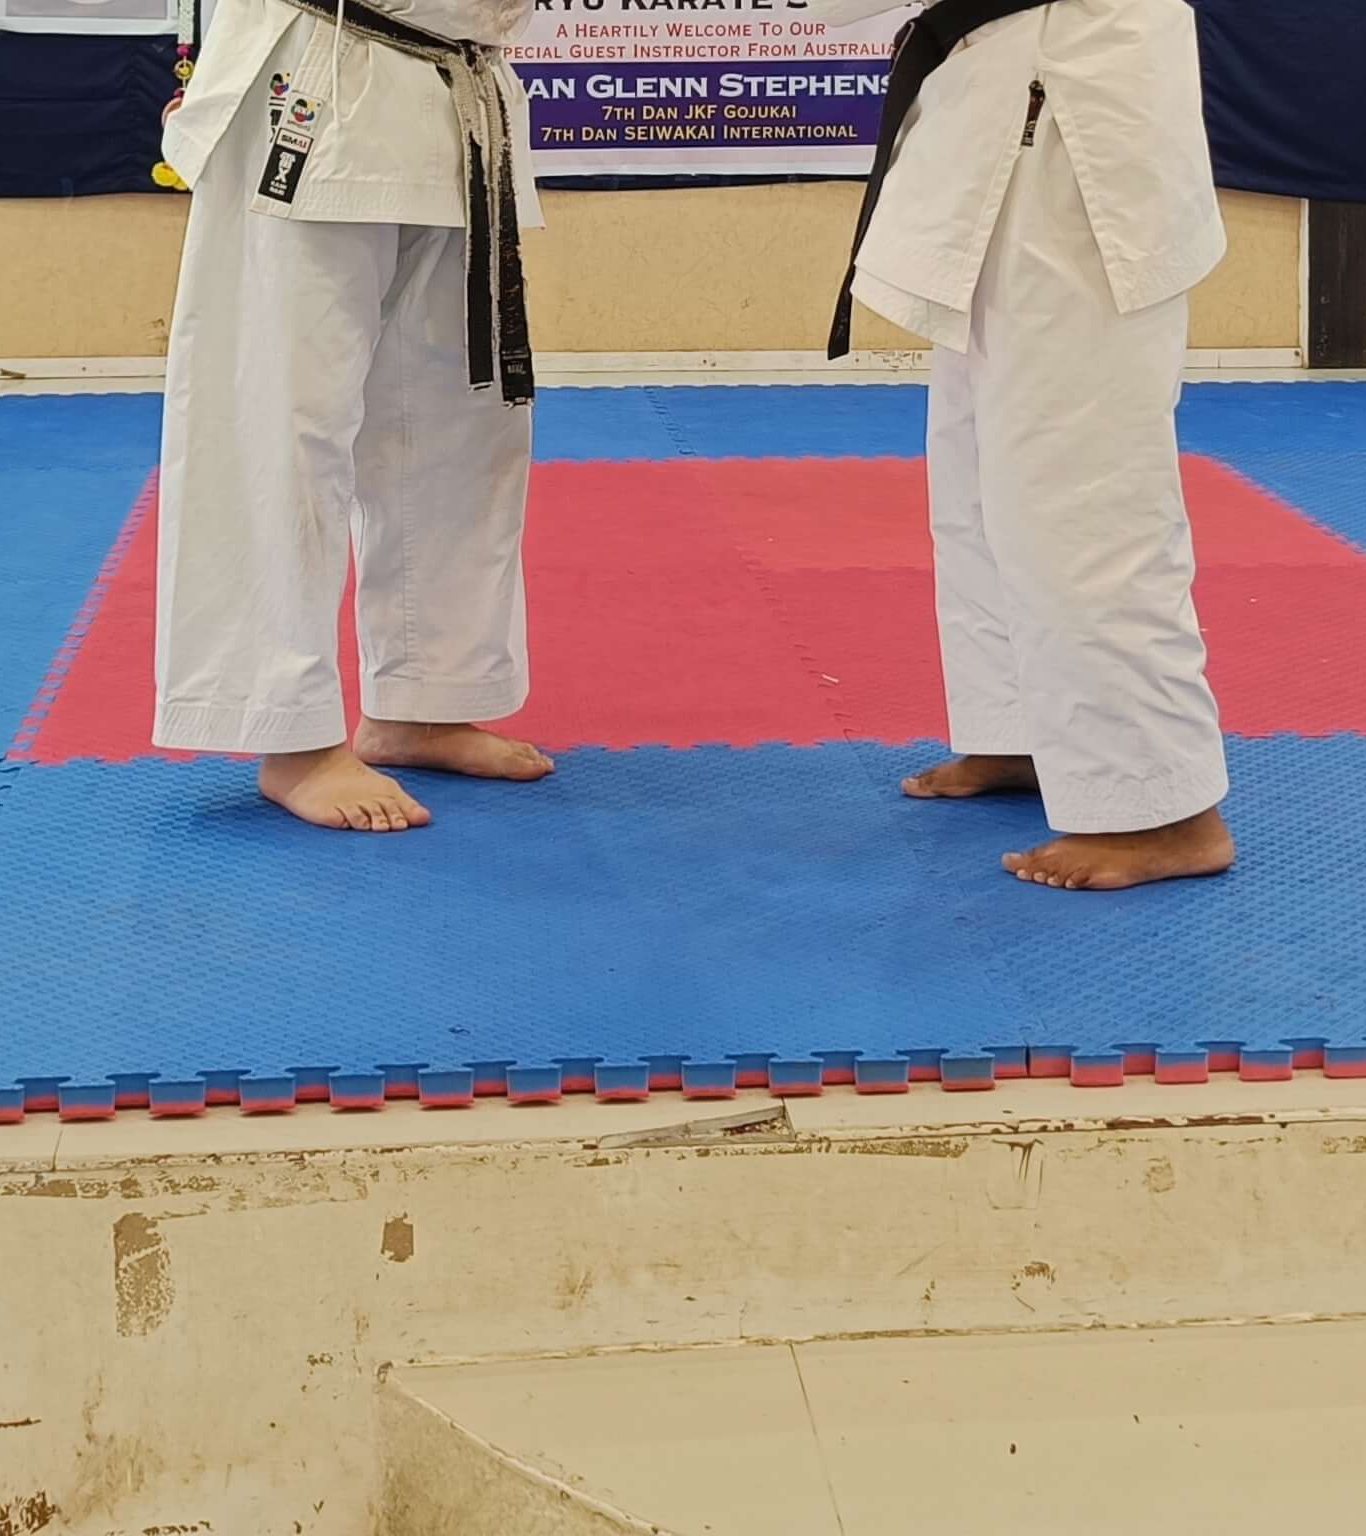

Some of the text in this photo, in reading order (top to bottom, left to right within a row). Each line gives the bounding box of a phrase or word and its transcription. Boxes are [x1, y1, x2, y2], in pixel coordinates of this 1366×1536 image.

[556, 21, 826, 38] A HEARTILY WELCOME TO OUR
[503, 47, 562, 60] PECIAL
[570, 44, 626, 59] GUEST
[634, 43, 741, 58] INSTRUCTOR
[748, 42, 796, 57] FROM
[586, 74, 708, 99] GLENN
[601, 104, 796, 120] 7TH DAN JKF GOJUKAI
[541, 124, 858, 142] 7TH DAN SEIWAKAI INTERNATIONAL
